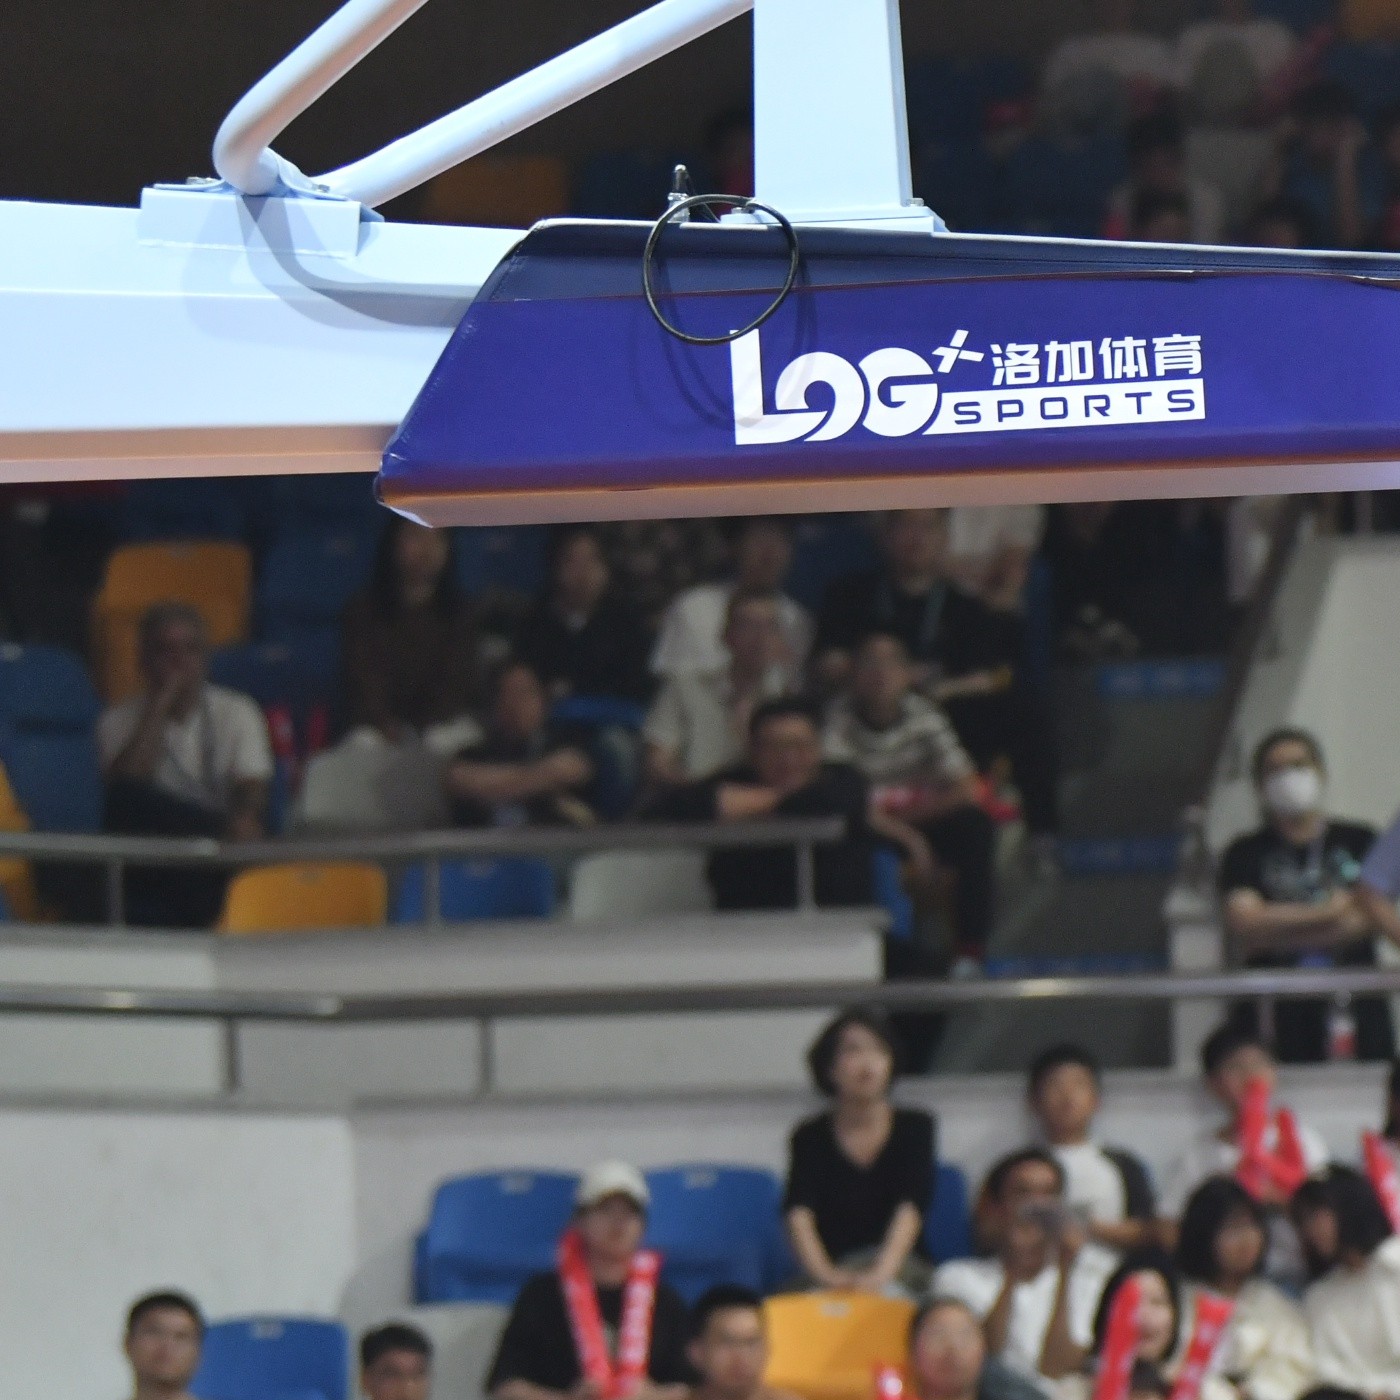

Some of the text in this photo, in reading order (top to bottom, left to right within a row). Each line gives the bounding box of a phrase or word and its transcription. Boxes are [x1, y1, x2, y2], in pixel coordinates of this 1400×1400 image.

[990, 333, 1202, 386] 洛加体育
[953, 388, 1198, 426] SPORTS
